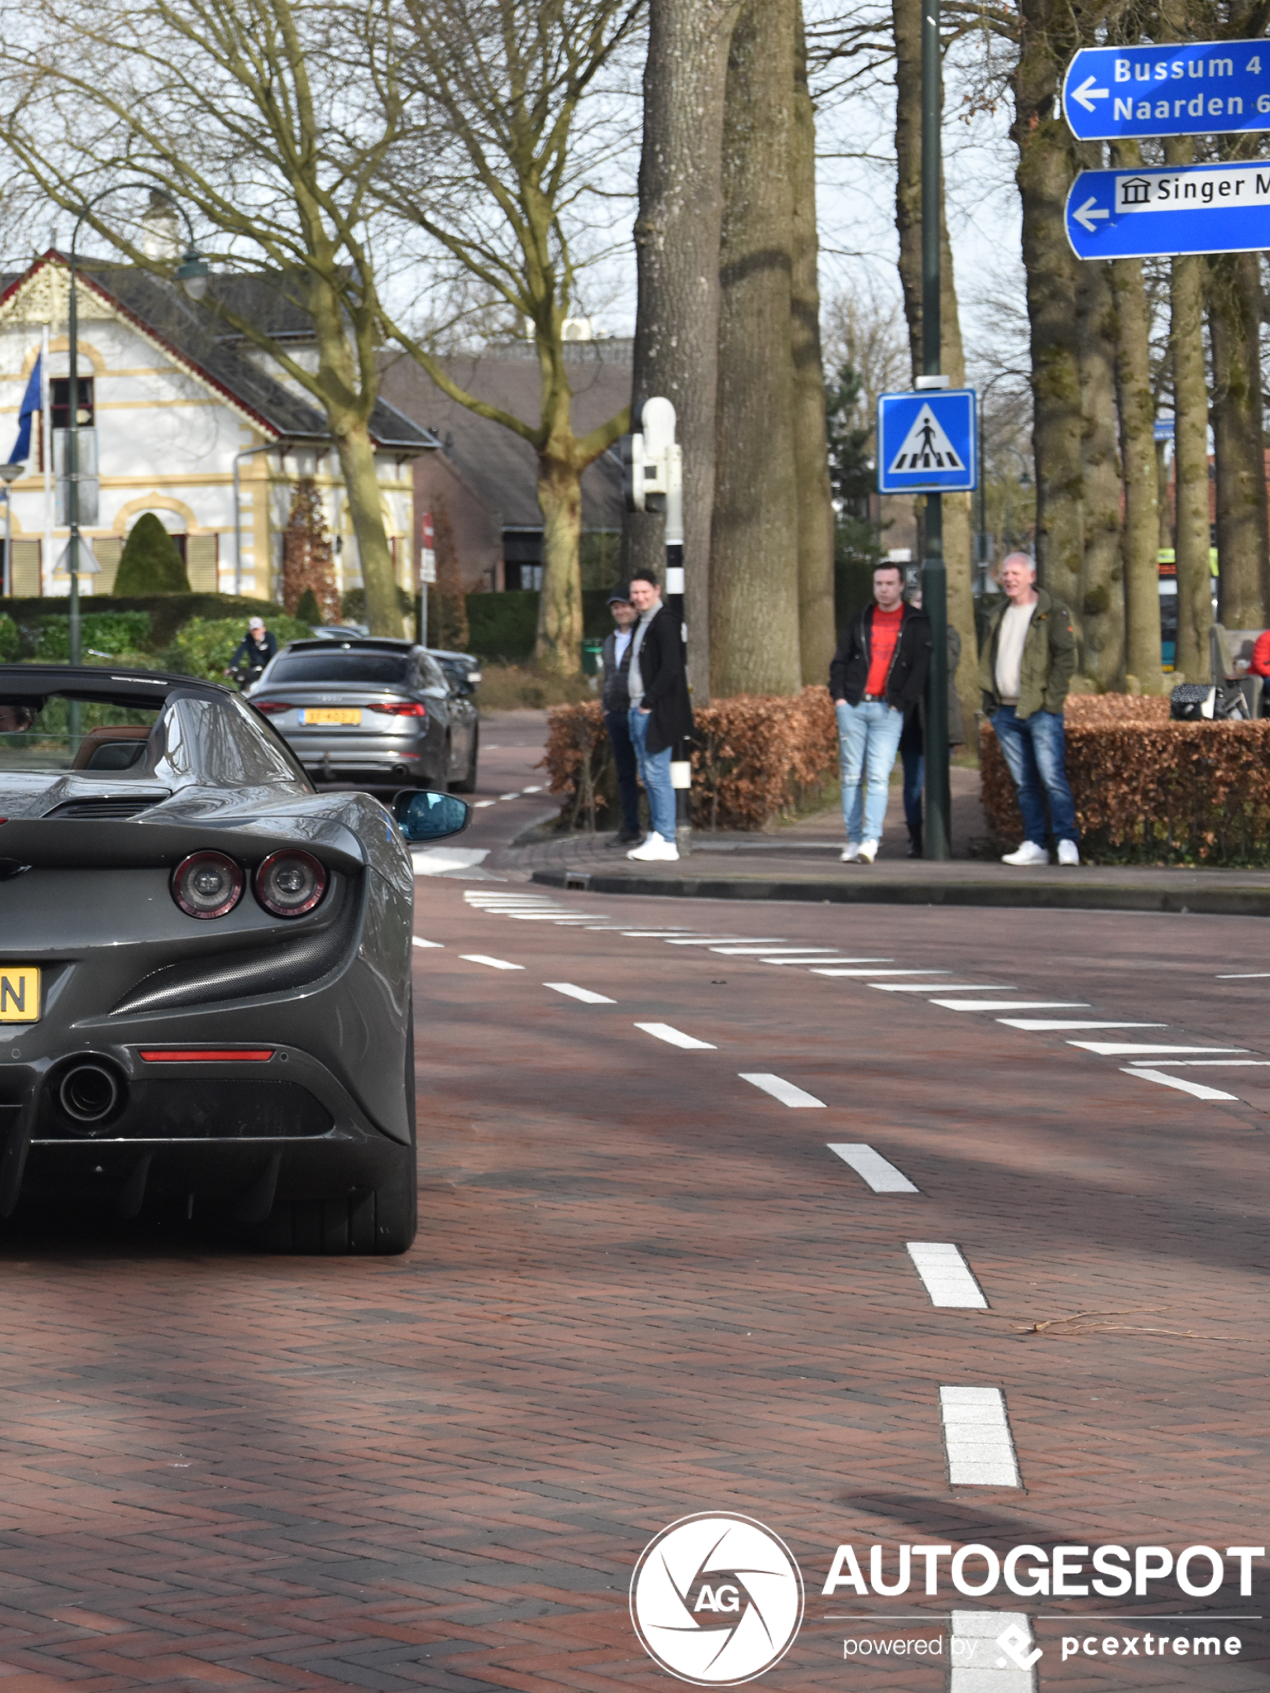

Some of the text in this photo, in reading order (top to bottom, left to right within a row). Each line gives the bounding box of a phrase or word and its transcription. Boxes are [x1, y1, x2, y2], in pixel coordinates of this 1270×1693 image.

[1114, 56, 1262, 83] Bussum 4
[1113, 93, 1270, 121] Naarden 6
[1157, 178, 1246, 203] Singer
